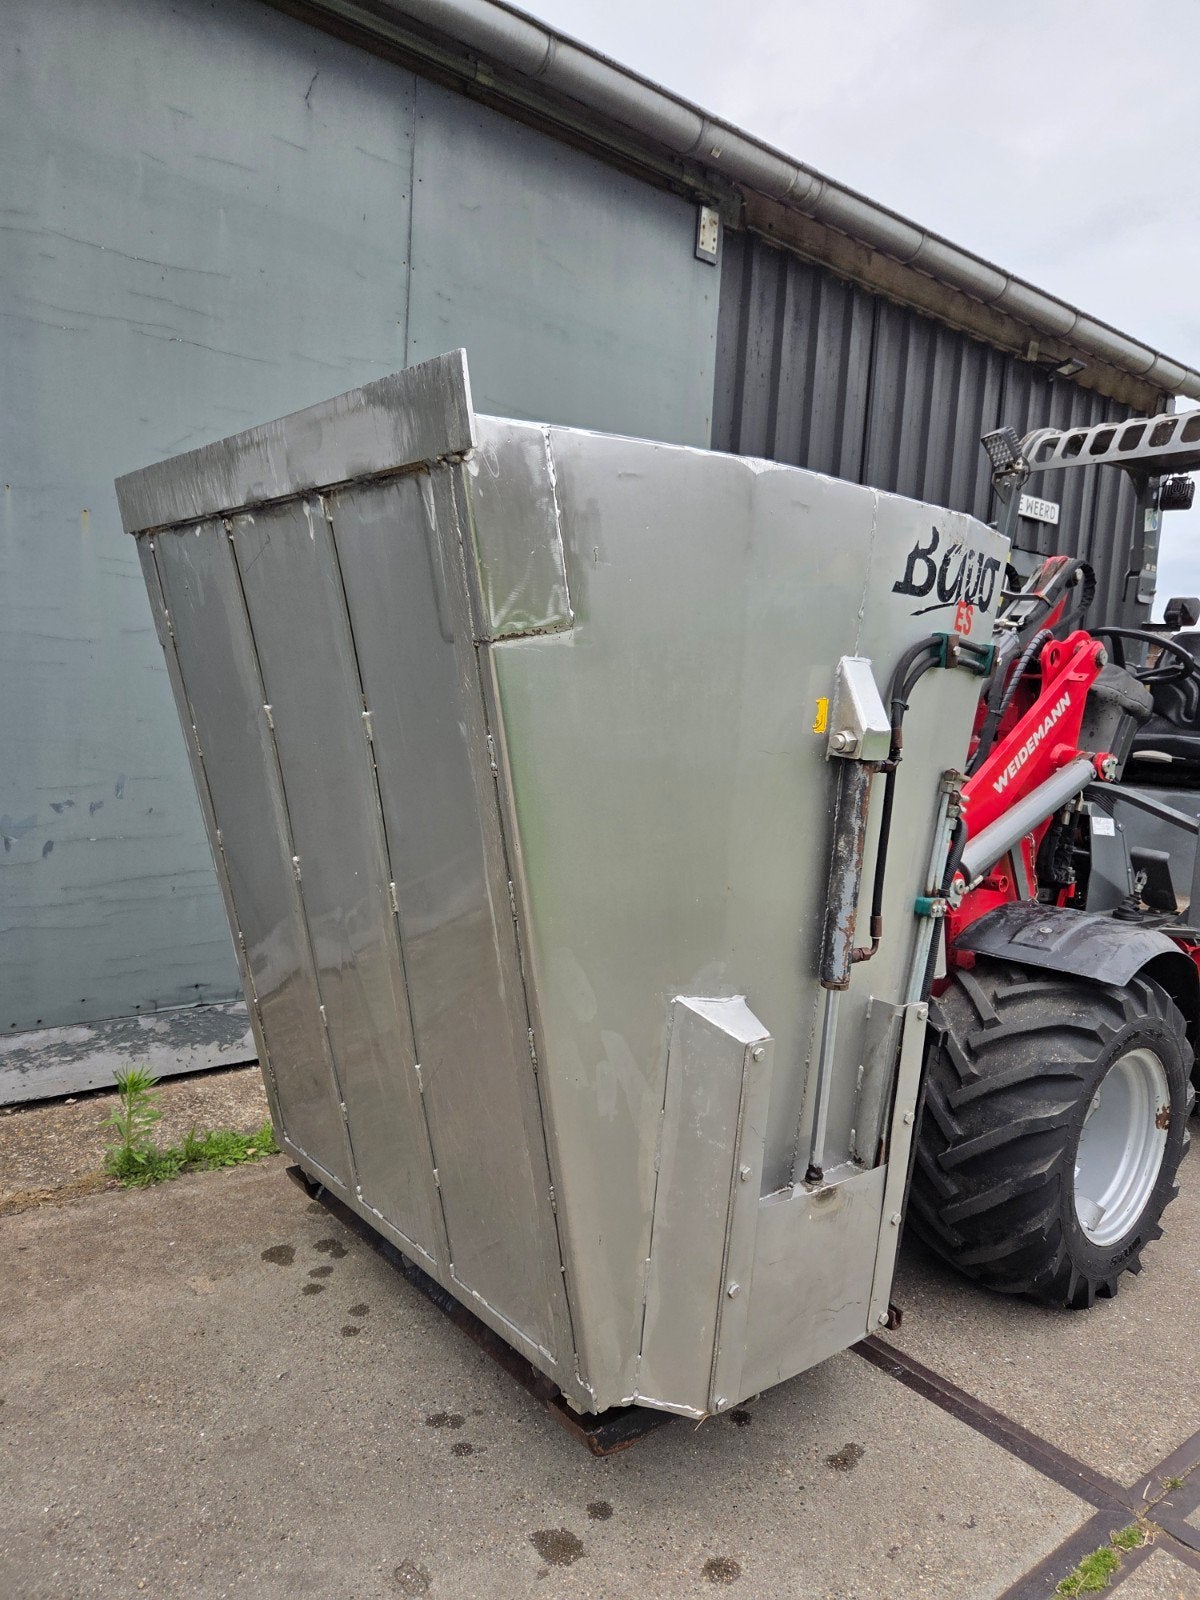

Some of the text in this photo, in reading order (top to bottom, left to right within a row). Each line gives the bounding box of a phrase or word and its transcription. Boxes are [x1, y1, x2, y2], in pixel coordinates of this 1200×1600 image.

[1025, 498, 1056, 520] WEERD
[954, 599, 974, 636] ES
[992, 691, 1072, 795] WEIDEMANN
